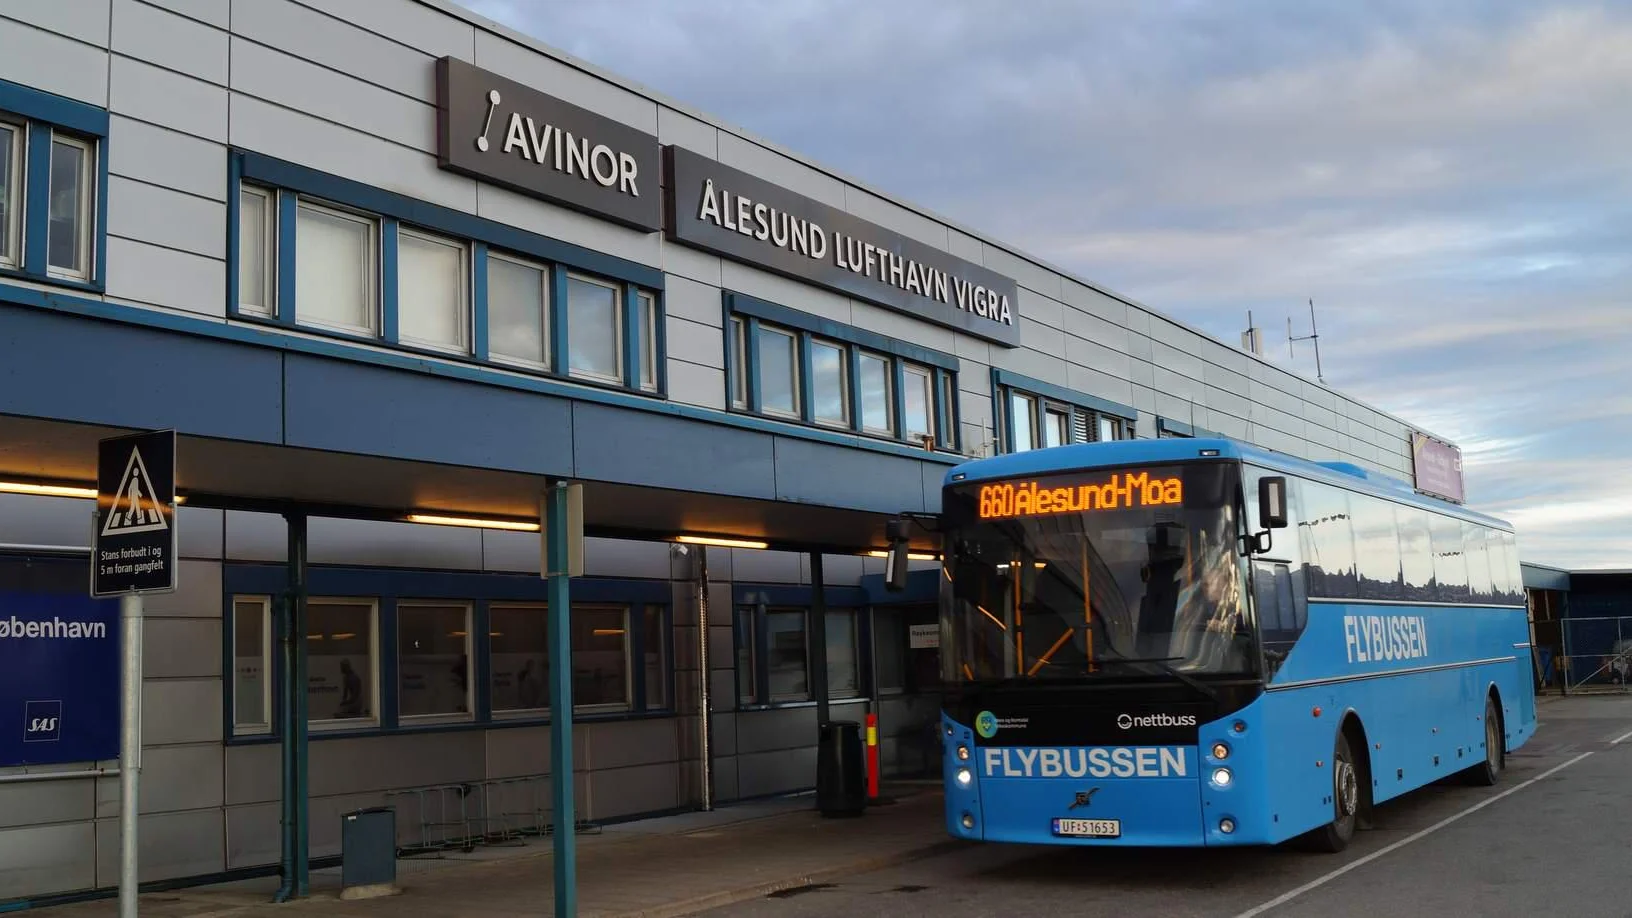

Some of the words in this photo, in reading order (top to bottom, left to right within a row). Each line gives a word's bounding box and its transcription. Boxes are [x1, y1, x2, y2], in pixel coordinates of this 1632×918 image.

[503, 111, 639, 197] AVINOR
[699, 178, 827, 259] ÅLESUND
[835, 231, 949, 303] LUFTHAVN
[953, 276, 1013, 326] VIGRA
[980, 484, 1014, 518] 660
[1015, 472, 1182, 515] Ålesund-Moa
[100, 565, 105, 575] 5
[106, 566, 114, 575] m
[115, 563, 133, 574] foran
[134, 560, 164, 575] gangfelt
[101, 550, 119, 561] Stans
[121, 546, 147, 558] forbudt
[152, 547, 162, 558] og
[1344, 615, 1428, 664] FLYBUSSEN
[27, 717, 58, 732] SAS
[1133, 713, 1197, 727] nettbuss
[984, 747, 1187, 778] FLYBUSSEN
